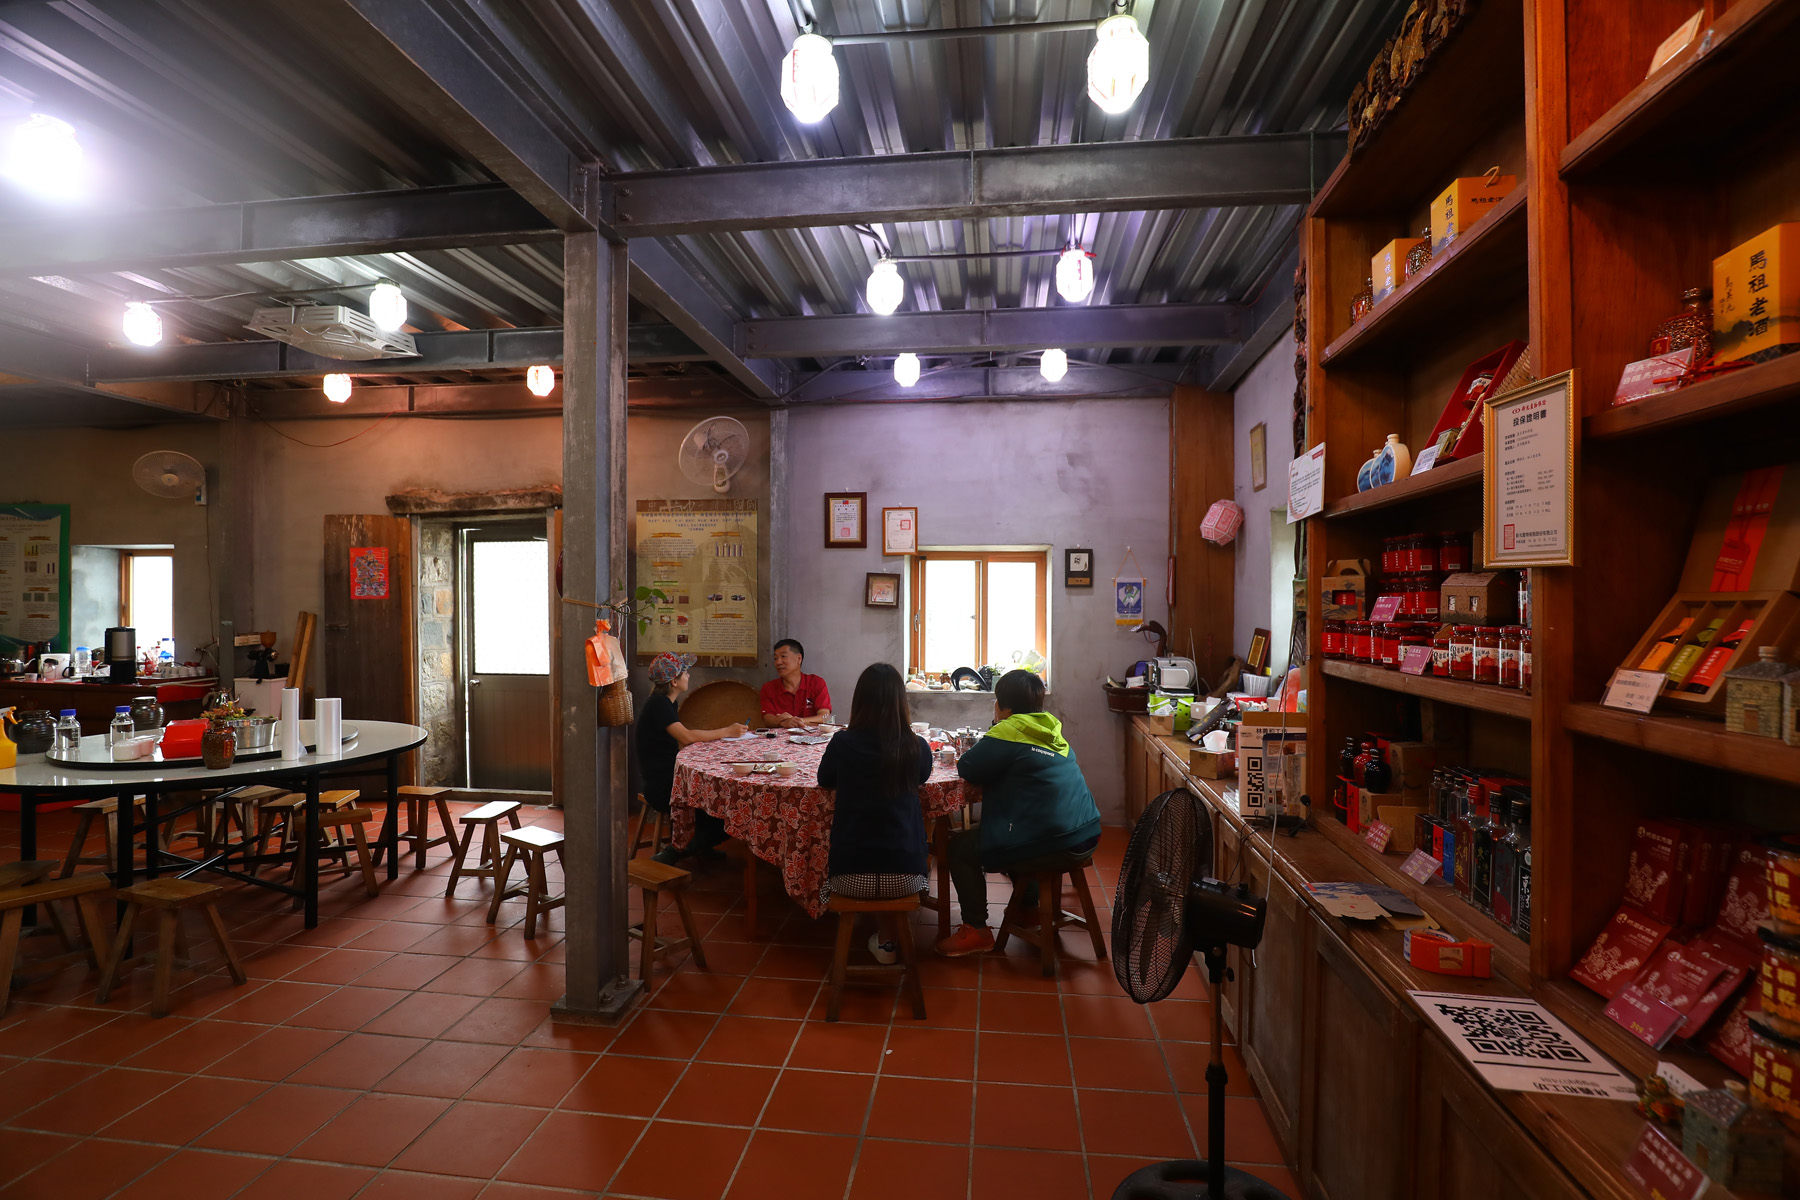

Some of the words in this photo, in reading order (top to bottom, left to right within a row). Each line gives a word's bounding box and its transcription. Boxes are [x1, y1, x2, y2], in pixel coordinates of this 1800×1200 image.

[1748, 250, 1769, 337] 馬祖老酒
[1513, 410, 1547, 426] 投保證明書
